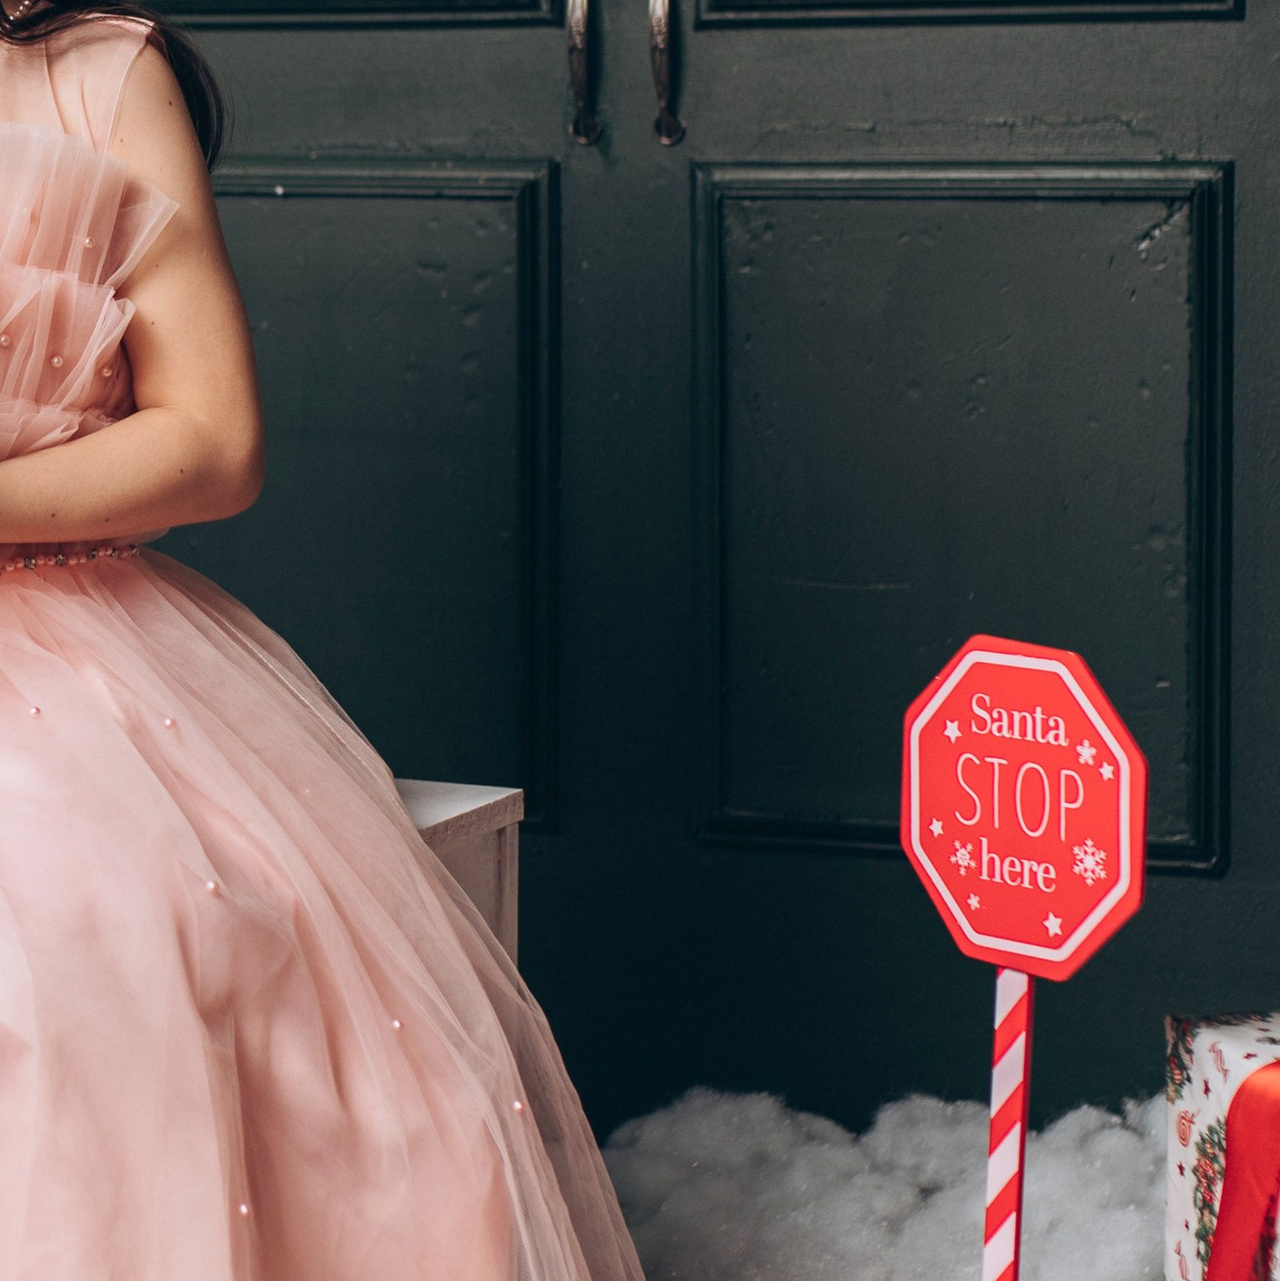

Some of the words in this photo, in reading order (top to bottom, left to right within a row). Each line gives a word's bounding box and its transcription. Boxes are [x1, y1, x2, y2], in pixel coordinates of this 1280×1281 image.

[970, 692, 1070, 747] Santa
[954, 752, 1085, 842] STOP
[978, 836, 1057, 893] here
